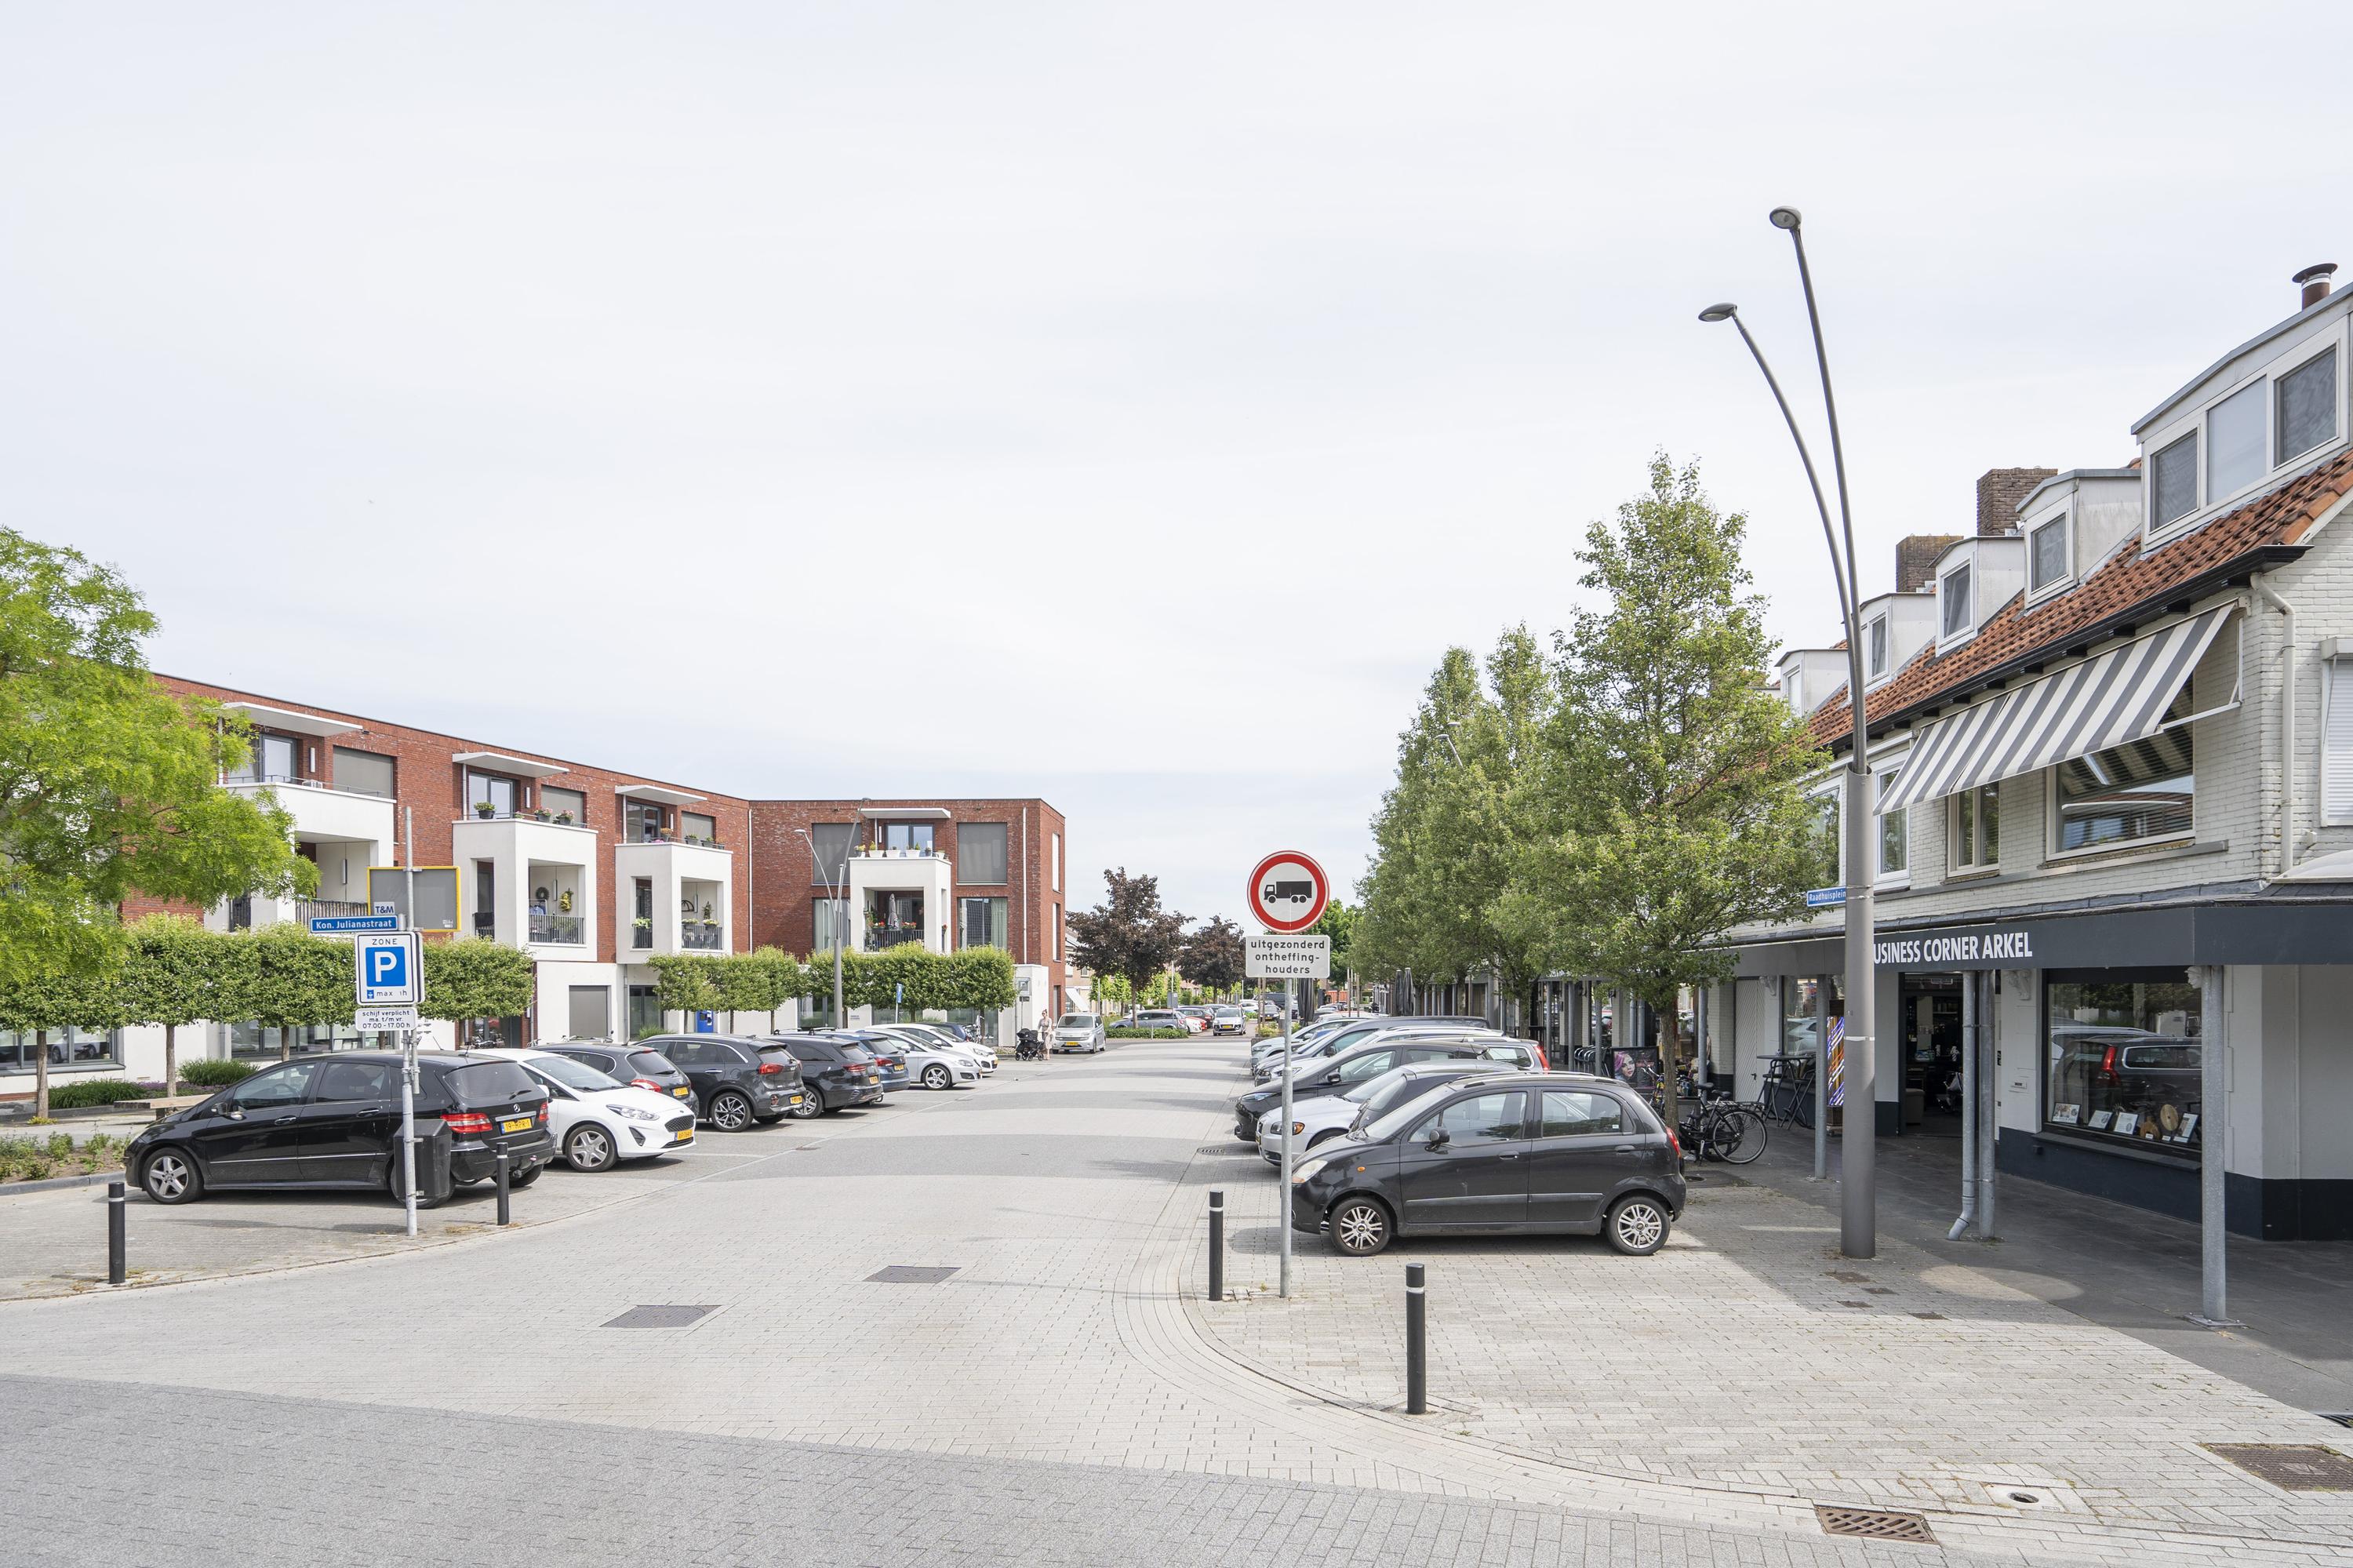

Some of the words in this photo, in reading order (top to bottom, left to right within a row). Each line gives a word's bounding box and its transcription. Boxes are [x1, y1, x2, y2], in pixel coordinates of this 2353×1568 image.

[1809, 890, 1846, 901] Raadhuisplein
[375, 905, 394, 914] T&M
[316, 921, 334, 930] Kon.
[336, 919, 392, 929] Julianastraat
[1251, 940, 1325, 951] uitgezonderd
[1874, 940, 1921, 964] USINESS
[1923, 936, 1979, 962] CORNER
[1981, 932, 2033, 959] ARKEL
[1255, 952, 1320, 963] ontheffing-
[374, 951, 397, 982] P
[1265, 966, 1310, 974] houders
